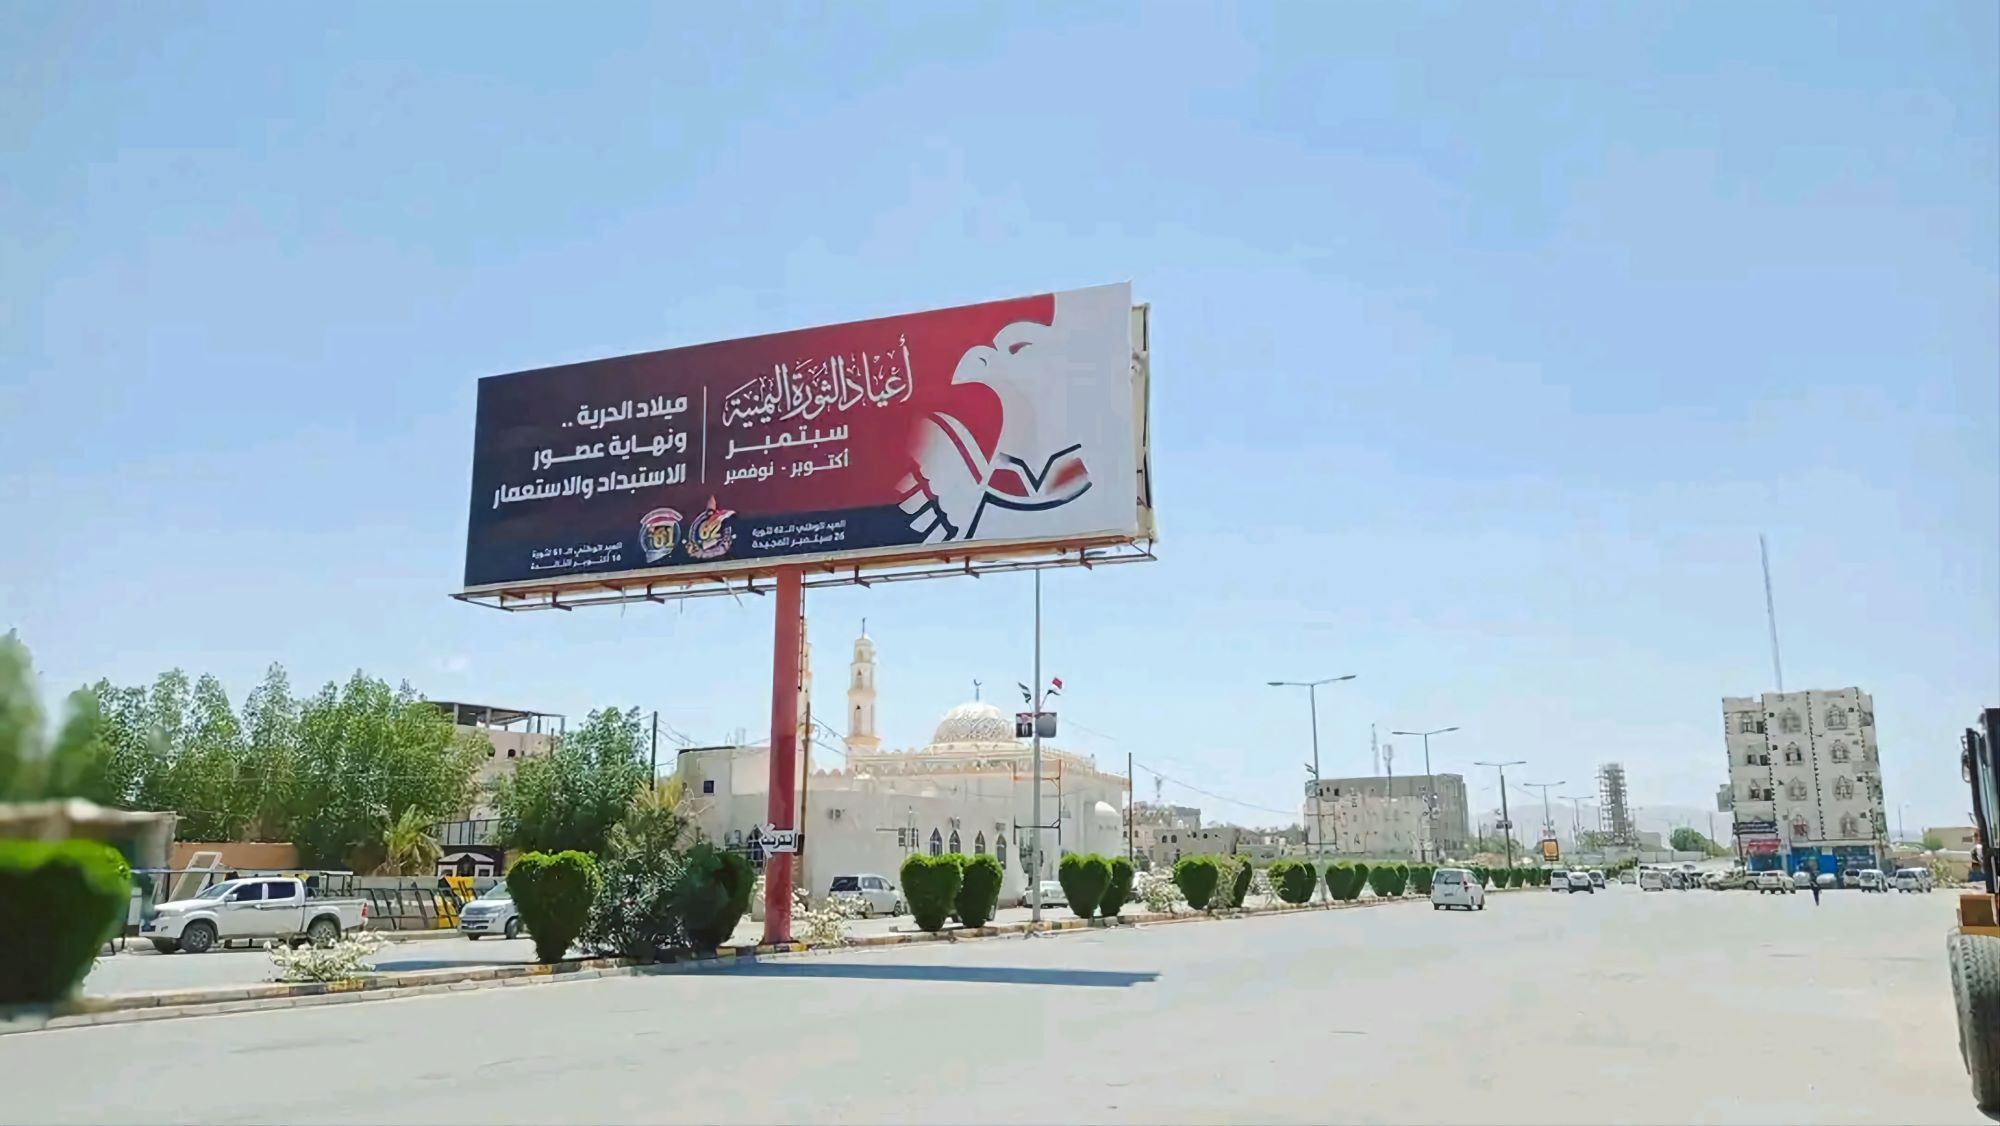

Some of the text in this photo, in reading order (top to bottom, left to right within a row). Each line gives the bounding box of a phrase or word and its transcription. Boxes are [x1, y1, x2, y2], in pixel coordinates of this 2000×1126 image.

[577, 400, 633, 430] الحرية
[636, 395, 688, 420] ميلاد
[532, 428, 688, 471] ونهاية عصور
[725, 424, 848, 459] سبتمبر
[723, 461, 774, 485] نوفمبر
[789, 448, 849, 478] أكتوبر
[492, 463, 687, 510] الاستبداد والاستعمار
